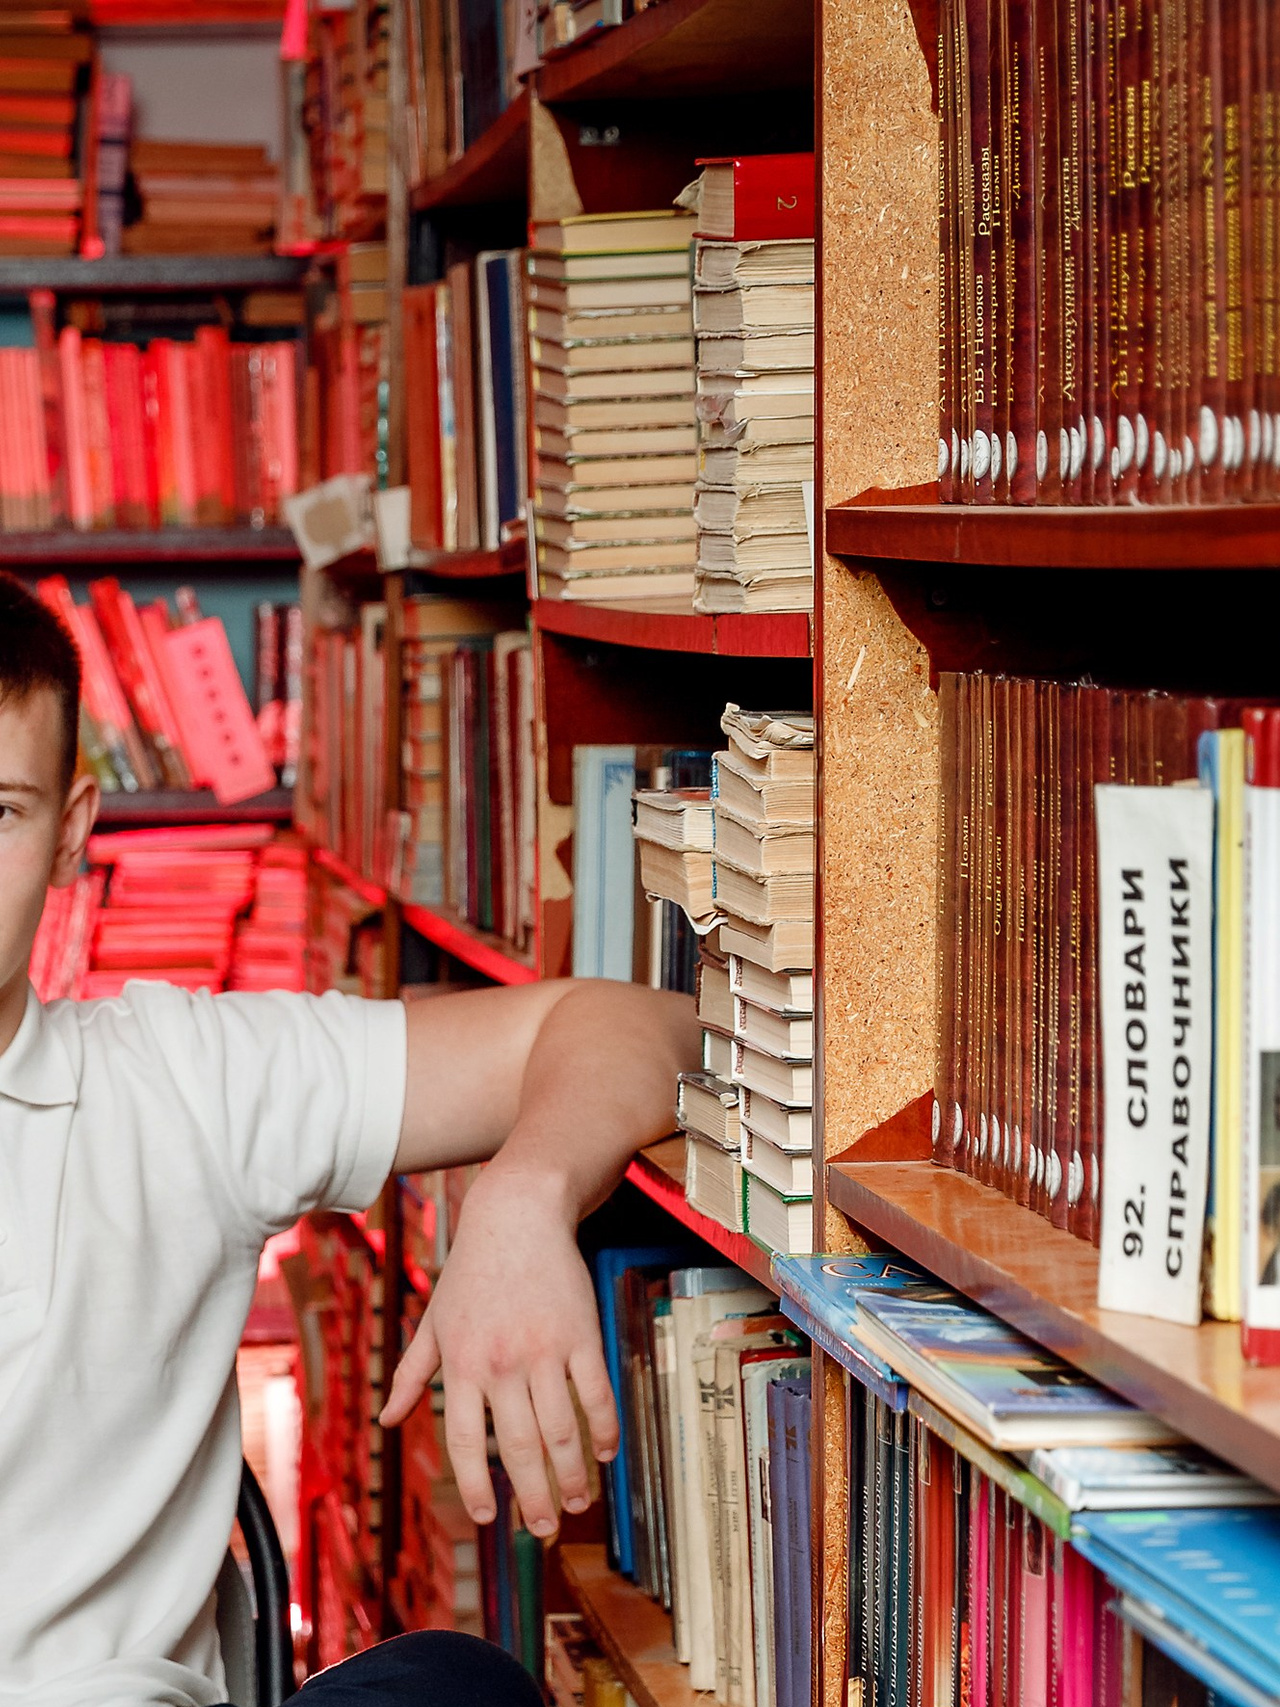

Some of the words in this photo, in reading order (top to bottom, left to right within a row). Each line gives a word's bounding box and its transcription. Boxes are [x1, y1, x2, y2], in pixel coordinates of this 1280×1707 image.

[1069, 100, 1082, 232] Драматические
[1122, 85, 1137, 189] Рассказы
[1138, 79, 1152, 183] Рассказы
[977, 147, 992, 237] Рассказы
[991, 154, 1001, 228] Поэмы
[1061, 156, 1073, 251] портреты
[973, 273, 985, 356] Набоков
[960, 813, 970, 881] Поэмы
[994, 834, 1004, 874] дети
[992, 887, 1005, 937] Отцы
[1122, 868, 1148, 1128] СЛОВАРИ
[1166, 858, 1191, 1278] СПРАВОЧНИКИ
[1123, 1184, 1145, 1258] 92.
[860, 1484, 870, 1593] АДМИРАЛОВ
[890, 1469, 901, 1608] АРХИТЕКТОРОВ
[860, 1593, 869, 1673] ВЕЛИКИХ
[889, 1608, 899, 1690] ВЕЛИКИХ
